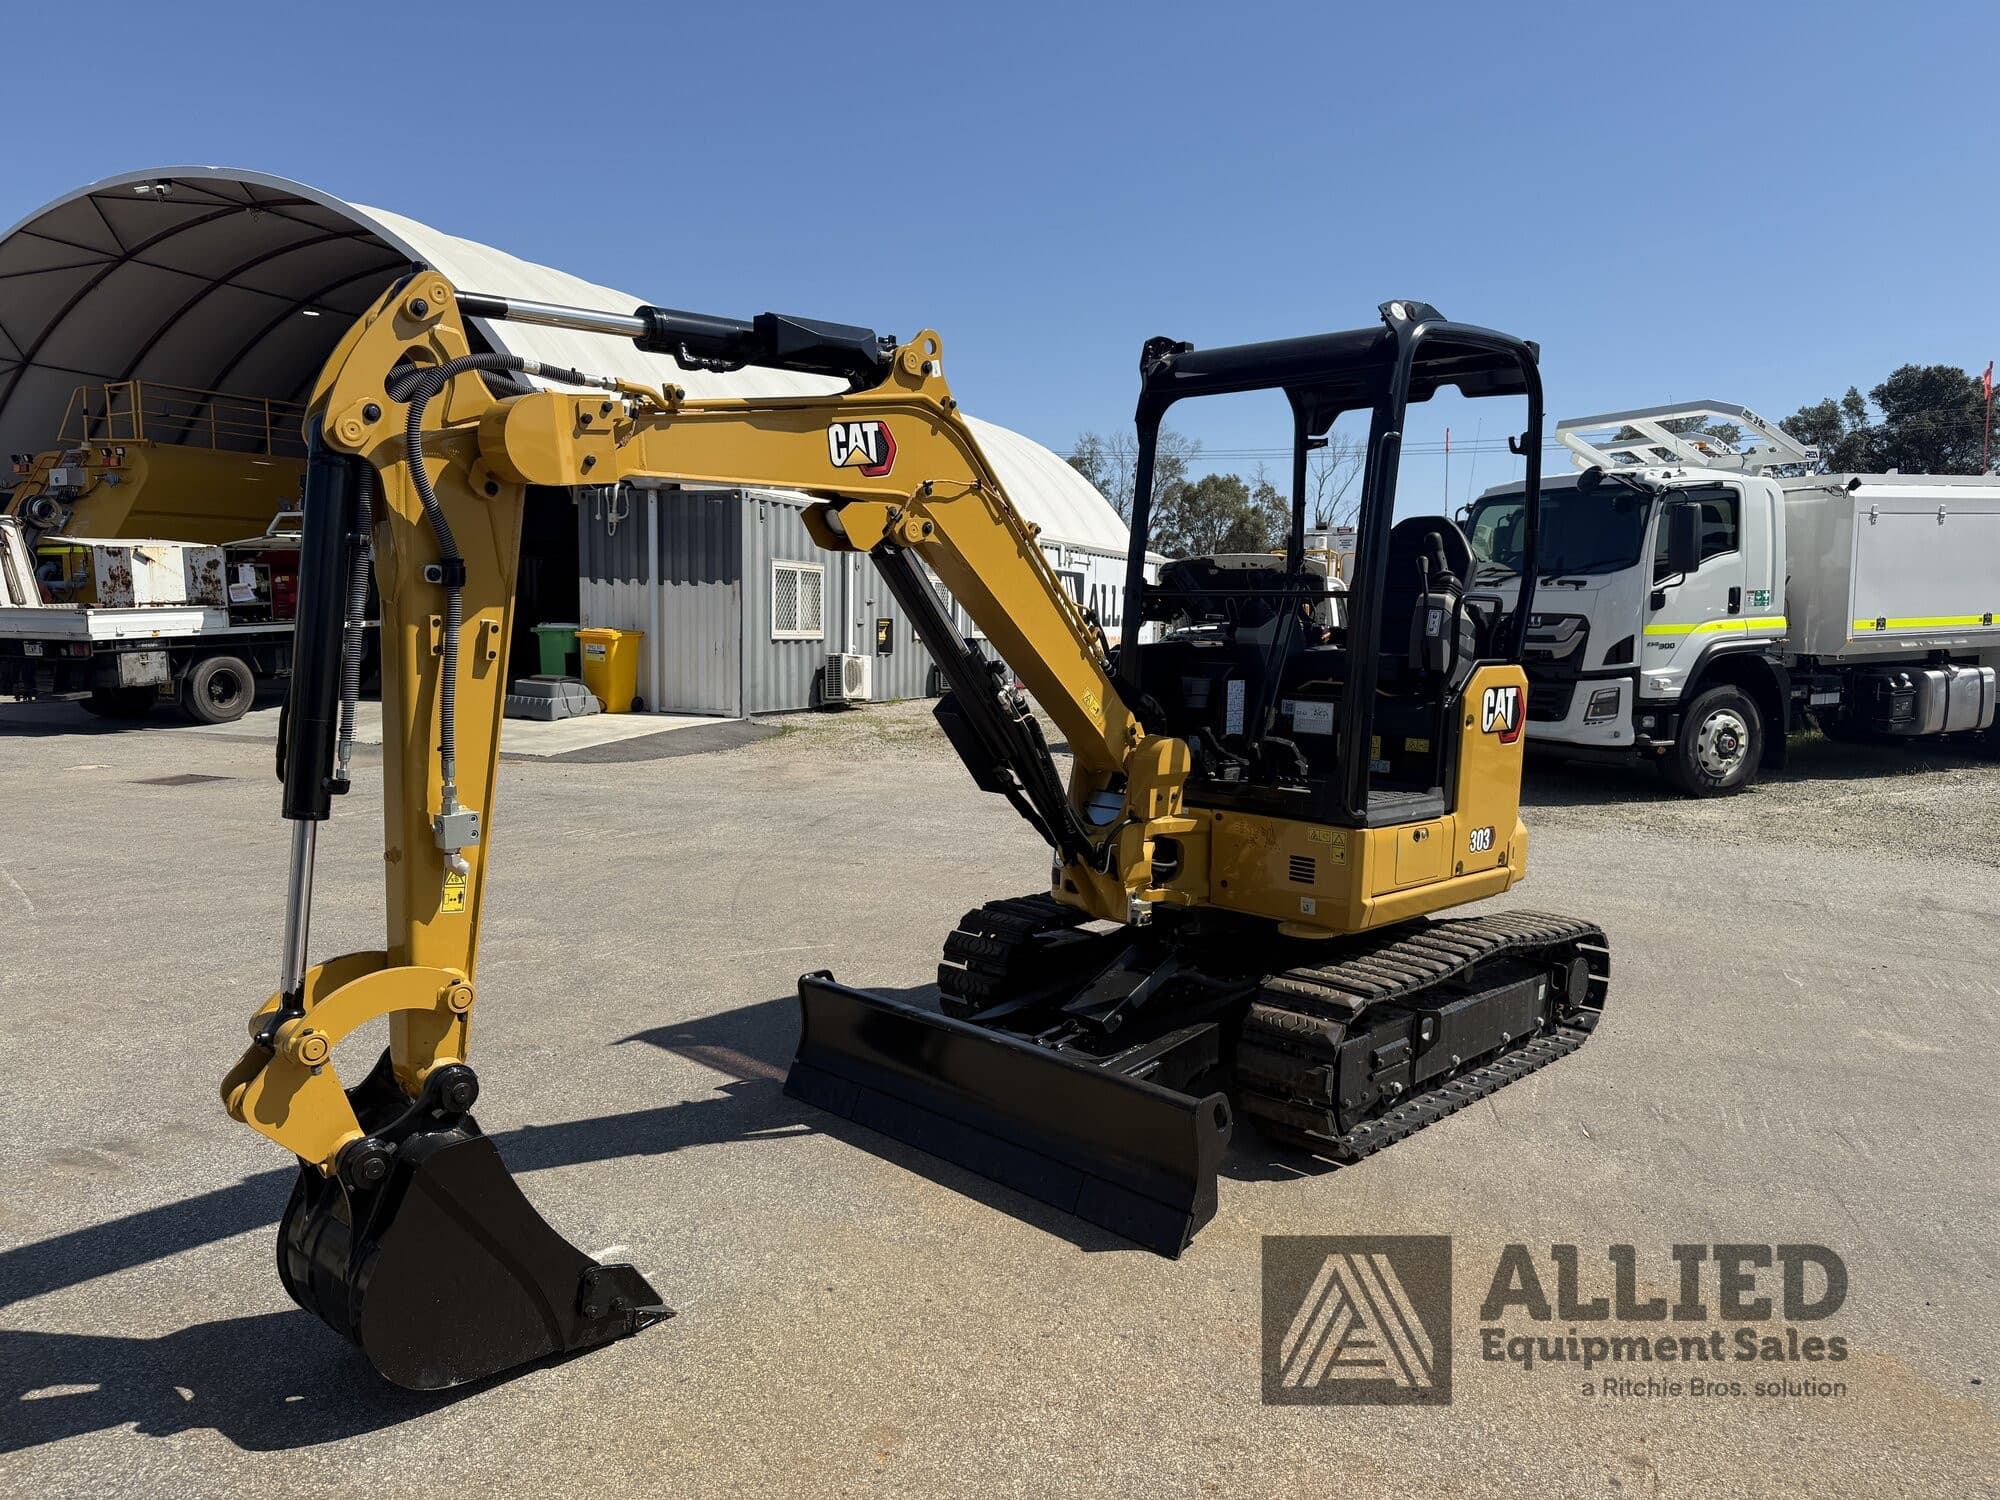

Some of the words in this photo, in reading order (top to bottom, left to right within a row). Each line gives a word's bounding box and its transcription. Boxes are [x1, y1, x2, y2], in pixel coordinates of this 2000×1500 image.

[828, 422, 879, 467] CAT
[1088, 583, 1126, 627] ALL
[1482, 687, 1517, 733] CAT
[1470, 828, 1491, 852] 303
